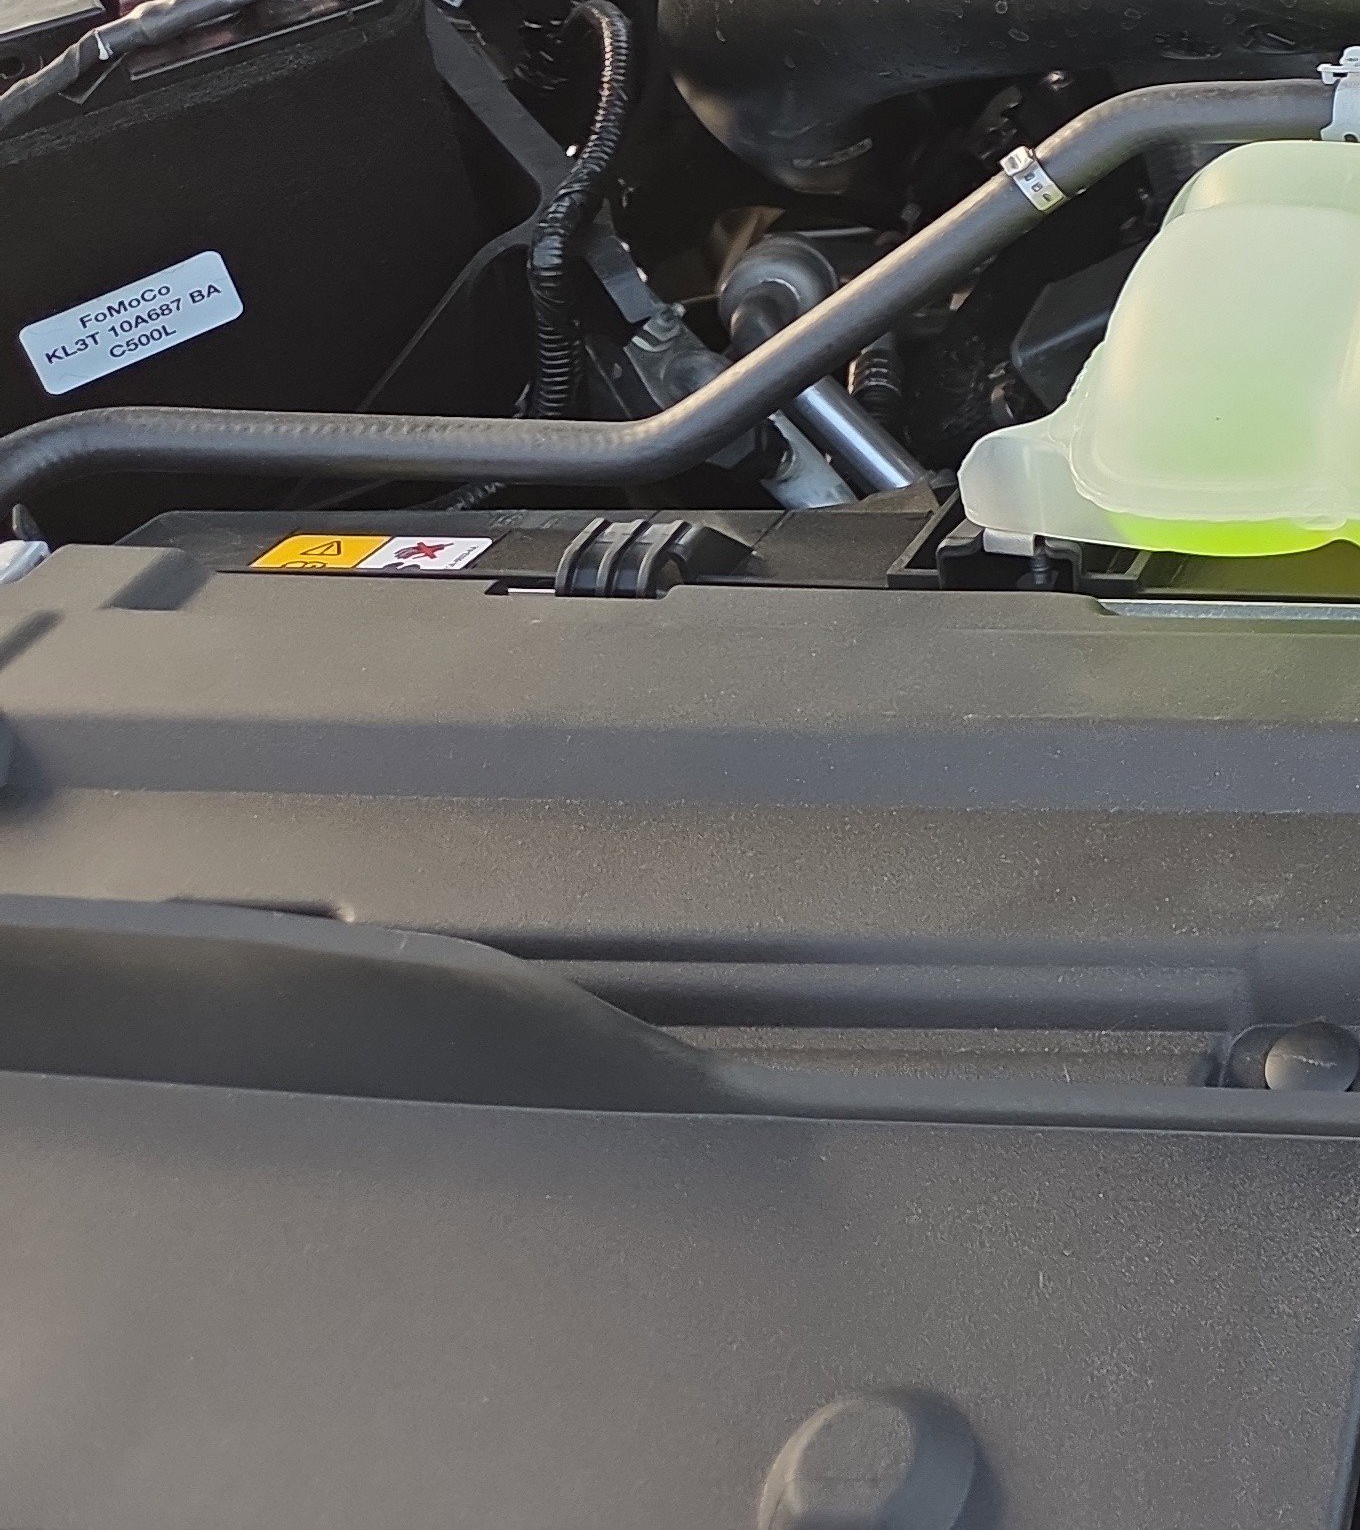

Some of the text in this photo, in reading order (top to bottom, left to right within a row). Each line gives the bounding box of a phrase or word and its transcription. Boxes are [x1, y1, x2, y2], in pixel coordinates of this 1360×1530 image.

[44, 283, 222, 365] KL3T 10A687 BA
[78, 283, 172, 329] FoMoCo
[109, 324, 177, 360] C500L
